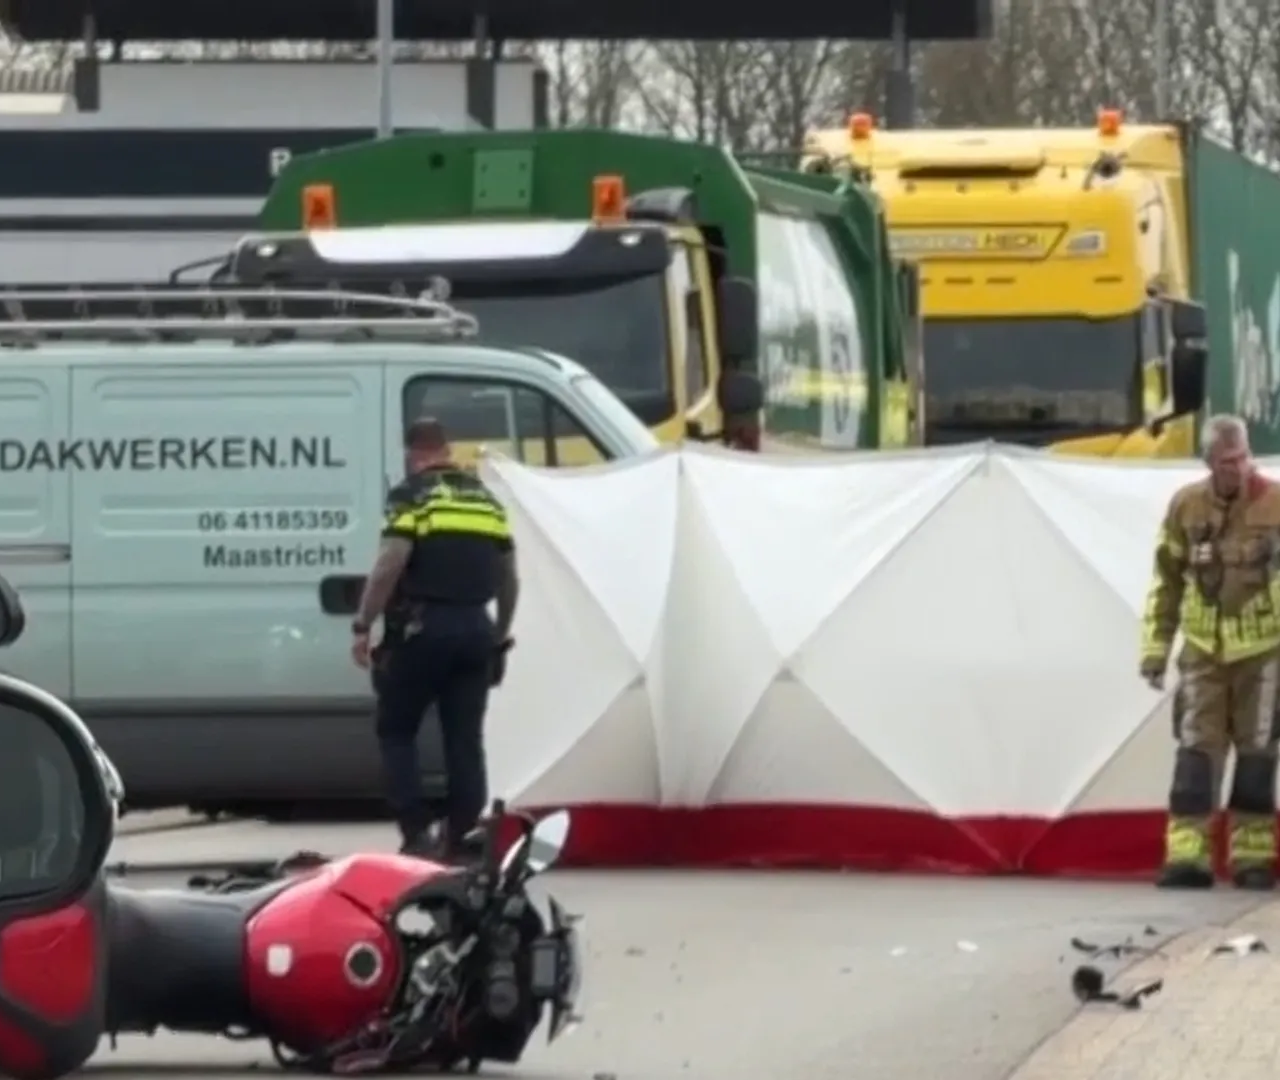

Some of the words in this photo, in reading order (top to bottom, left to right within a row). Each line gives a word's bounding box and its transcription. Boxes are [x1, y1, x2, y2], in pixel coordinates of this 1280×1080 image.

[197, 511, 227, 533] 06
[233, 509, 350, 533] 41185359
[202, 544, 347, 570] Maastricht
